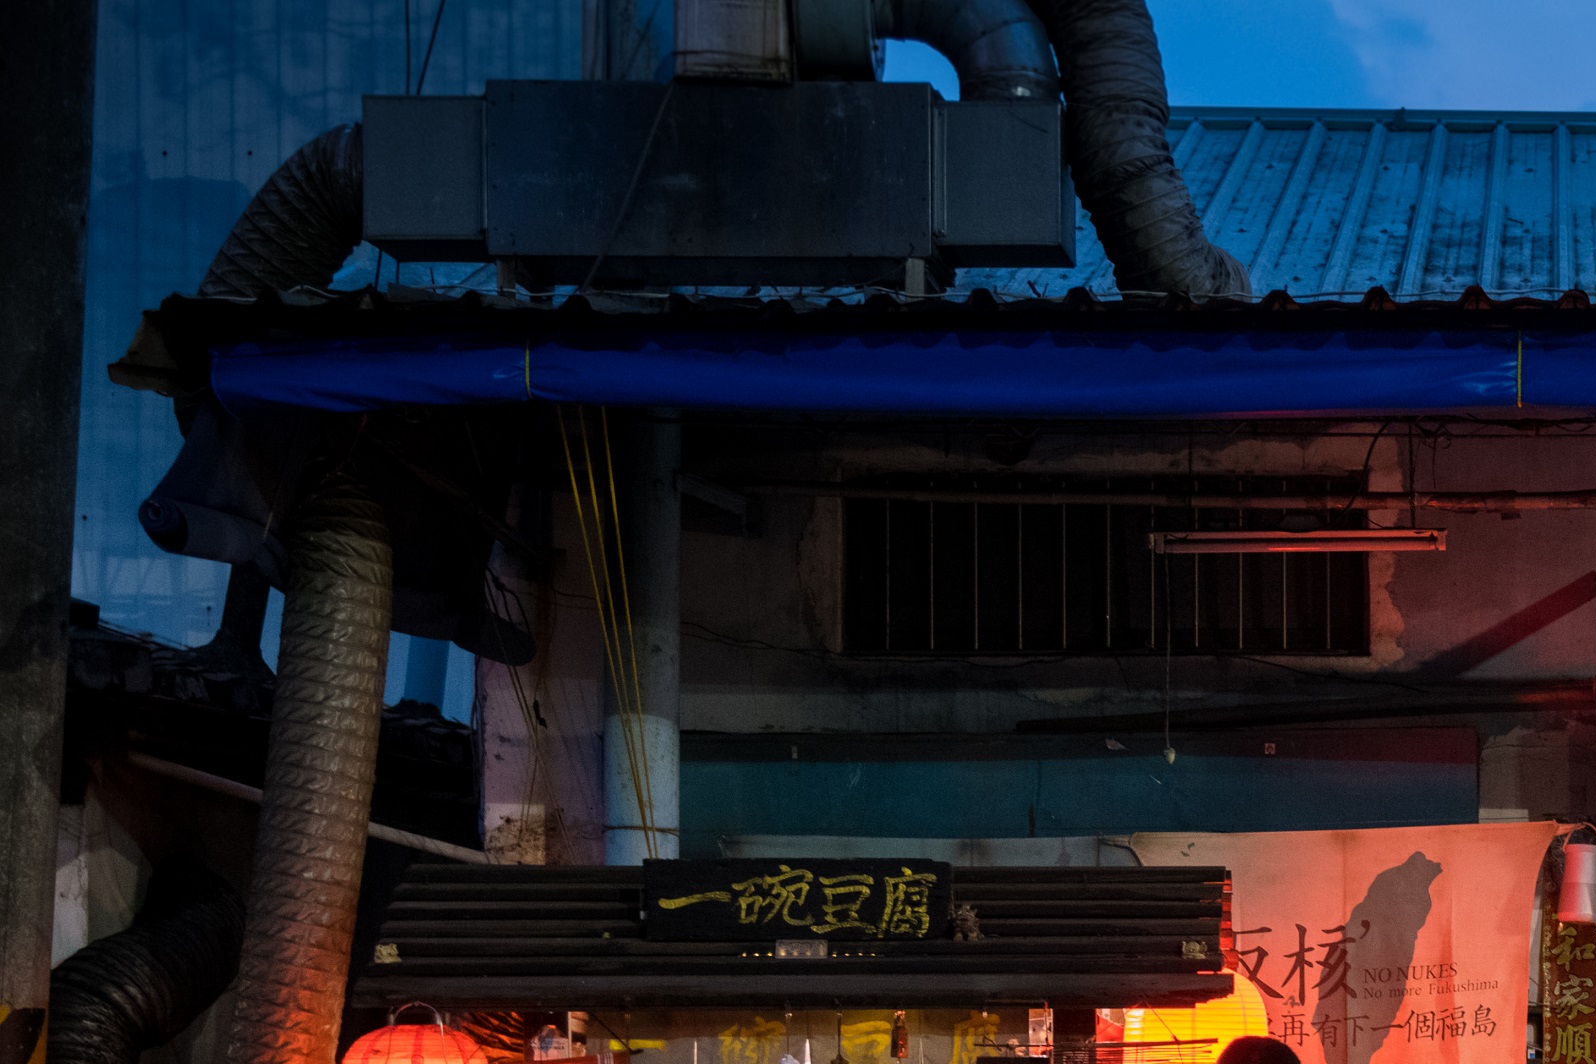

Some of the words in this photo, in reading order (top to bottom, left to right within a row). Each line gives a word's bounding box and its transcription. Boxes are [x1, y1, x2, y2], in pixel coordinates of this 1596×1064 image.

[658, 864, 938, 938] 一碗豆腐
[1362, 968, 1392, 984] NO
[1395, 962, 1458, 982] NUKES
[1363, 986, 1383, 1000] No
[1389, 985, 1422, 998] more
[1428, 978, 1499, 996] Fukushima
[1268, 1003, 1498, 1047] 再有下一個福島
